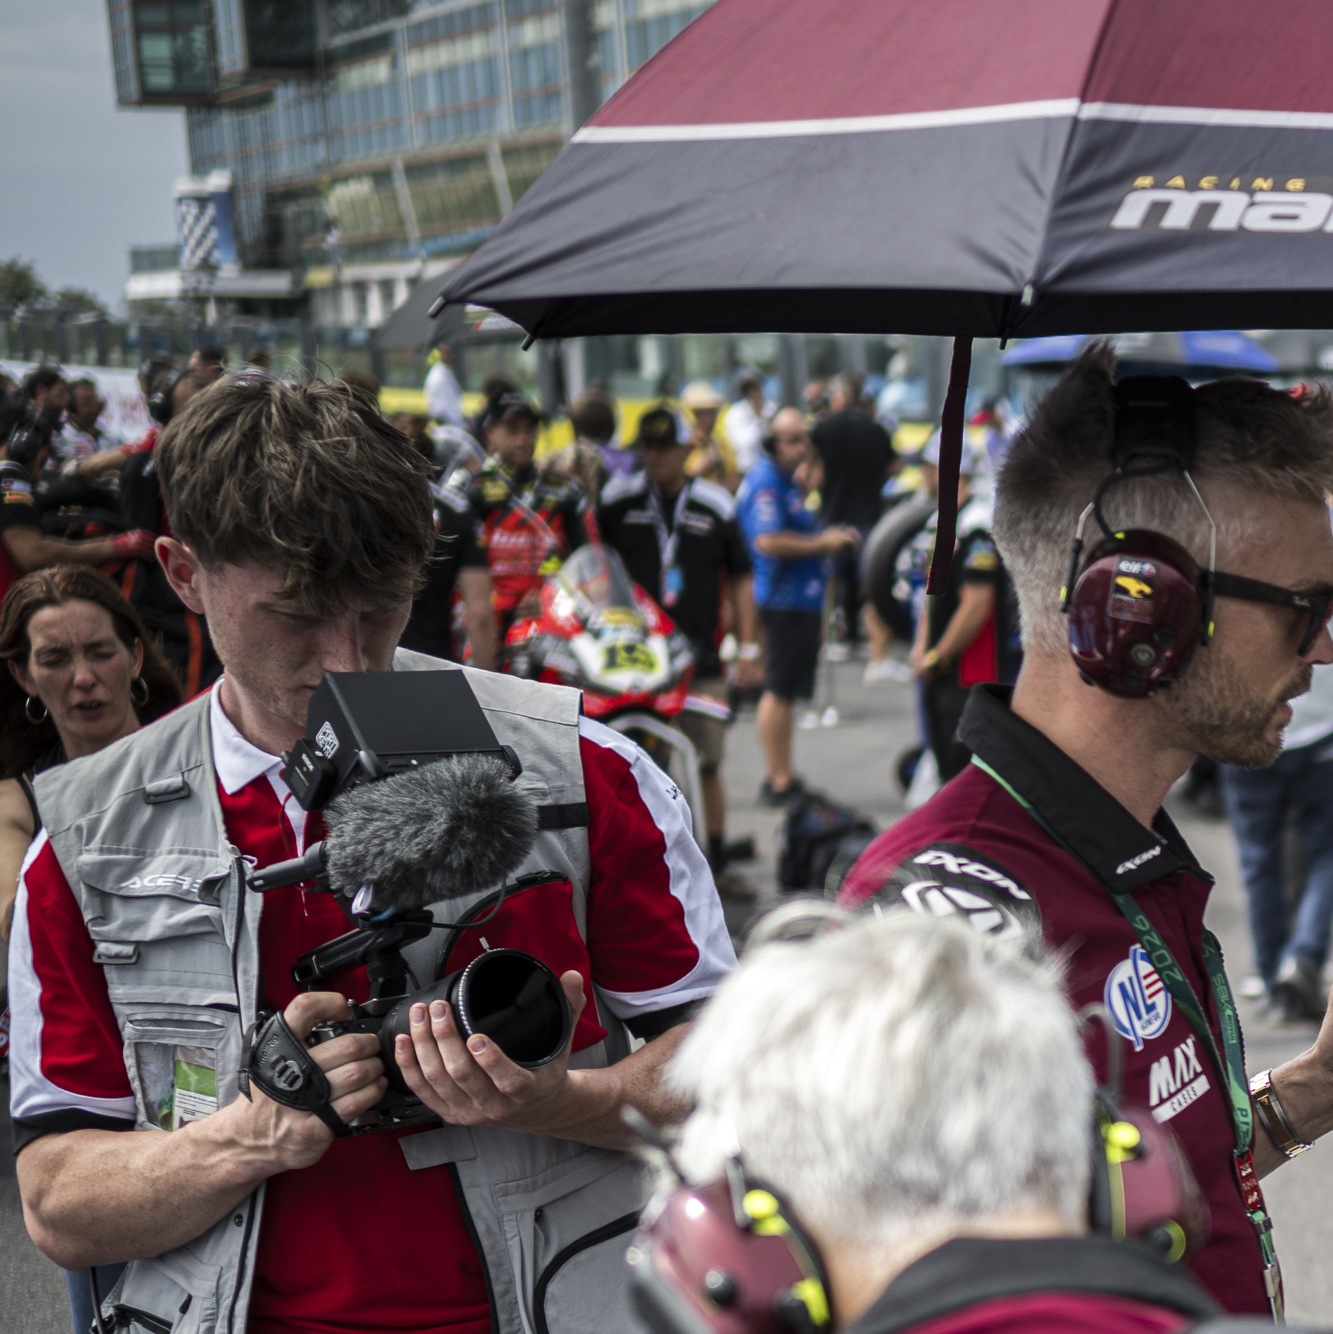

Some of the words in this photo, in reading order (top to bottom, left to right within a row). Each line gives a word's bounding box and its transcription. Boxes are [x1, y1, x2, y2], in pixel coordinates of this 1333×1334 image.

[1133, 175, 1306, 192] RACING
[1118, 559, 1143, 574] elf
[1133, 915, 1184, 986] 2026
[1149, 1037, 1204, 1107] MAX
[1171, 1086, 1198, 1113] CASES
